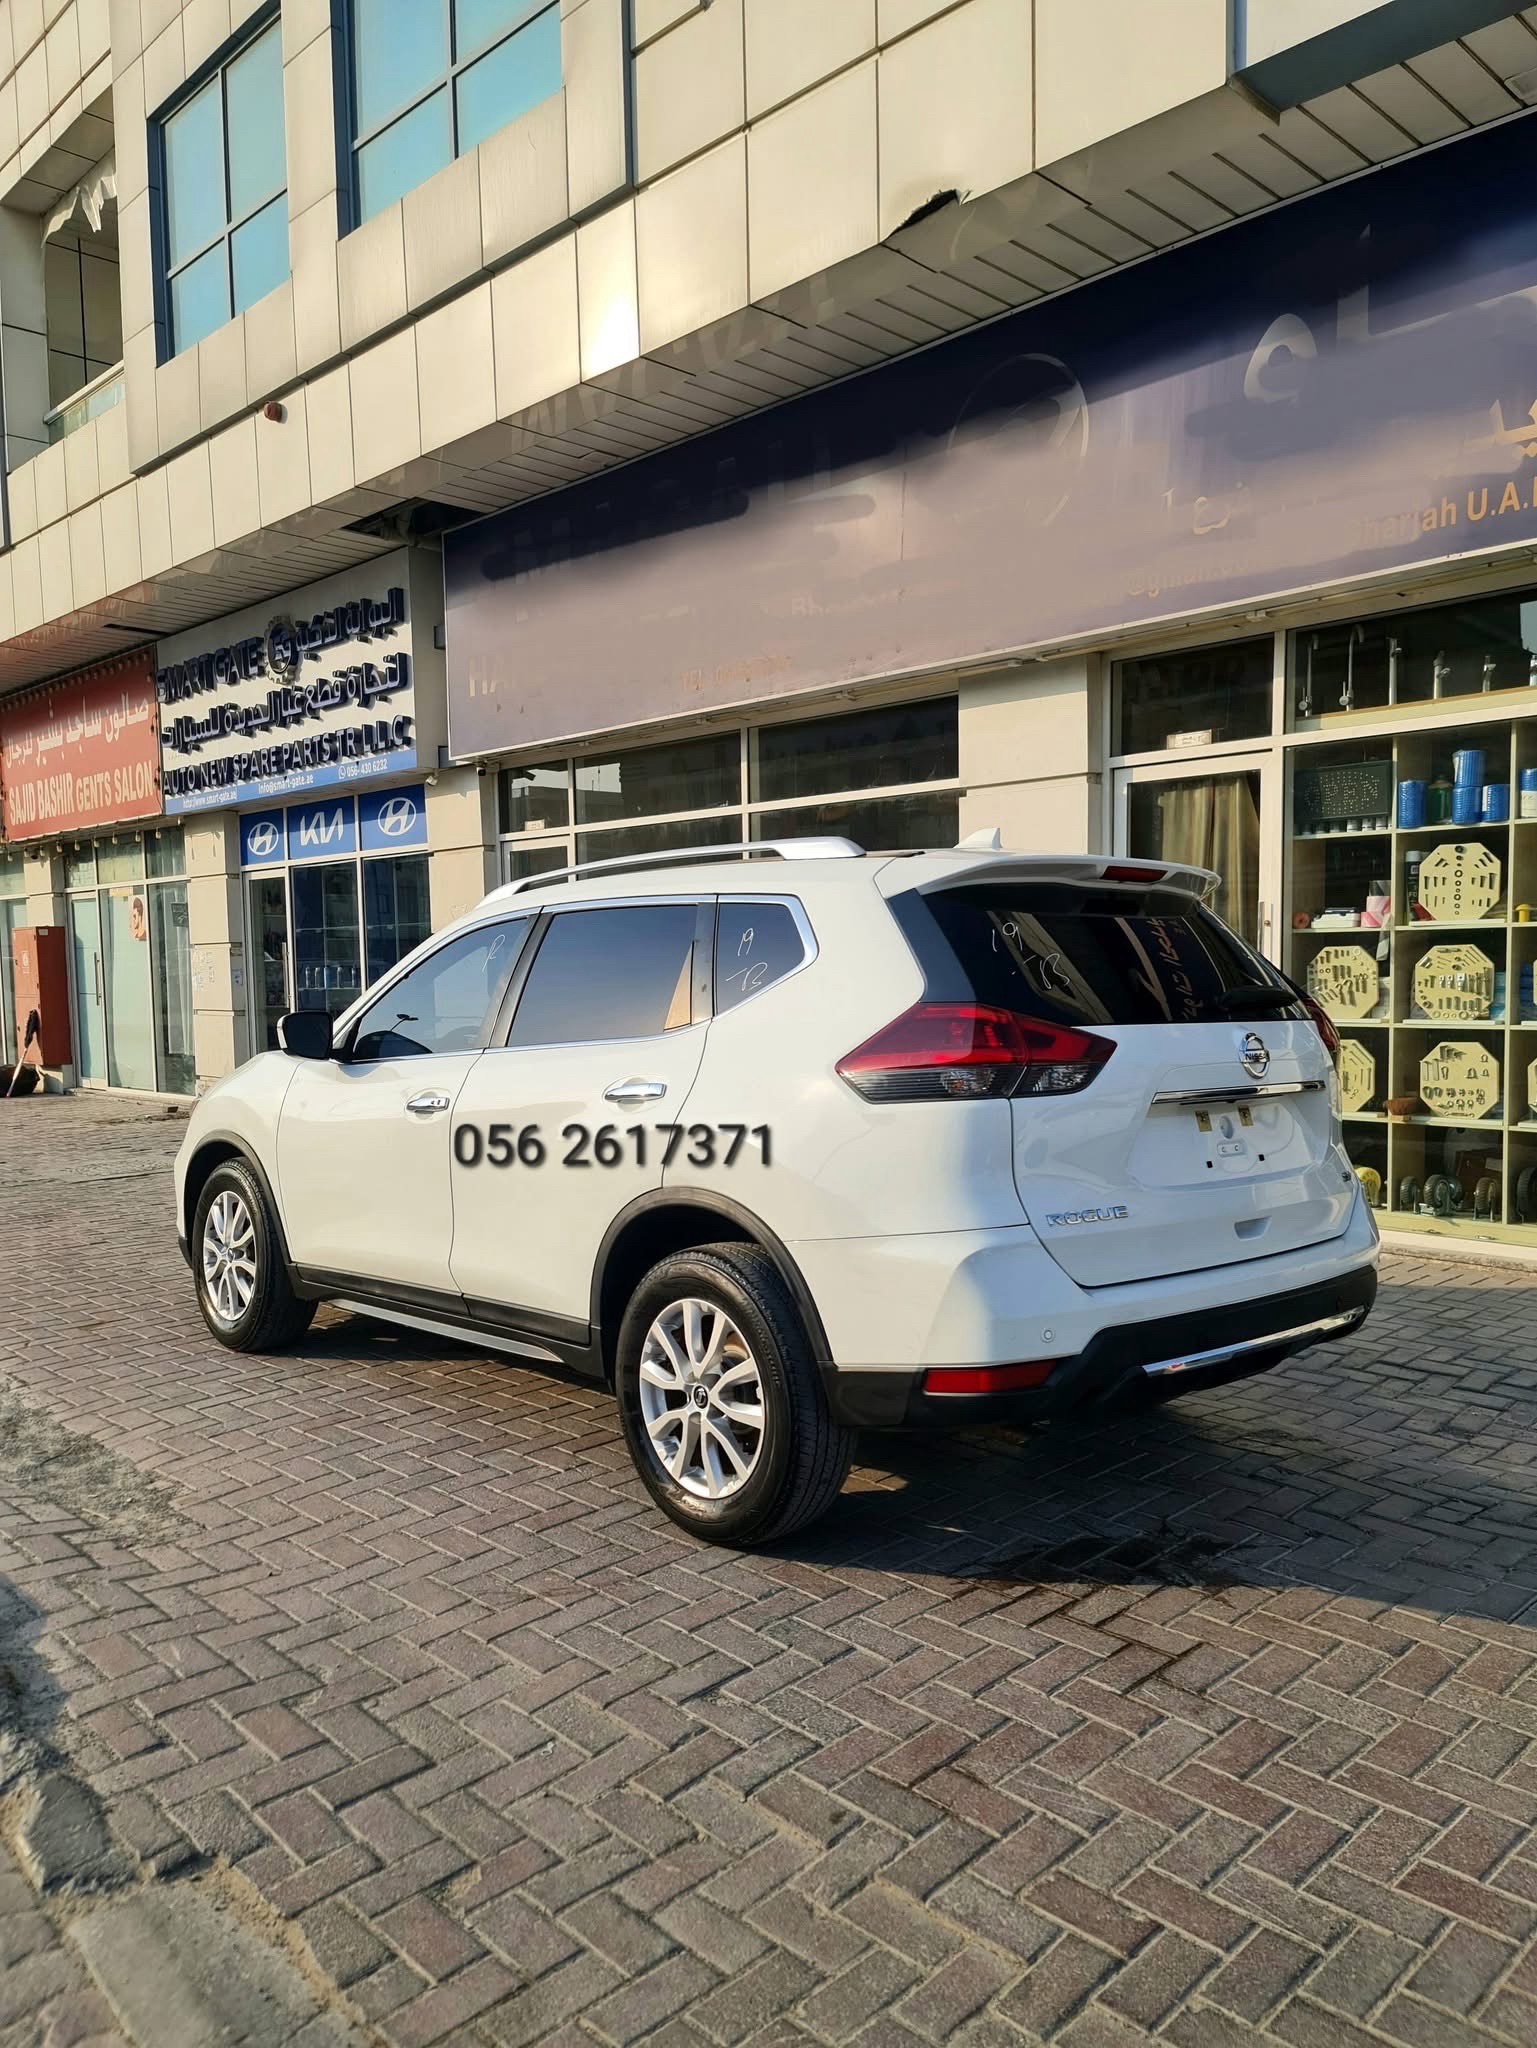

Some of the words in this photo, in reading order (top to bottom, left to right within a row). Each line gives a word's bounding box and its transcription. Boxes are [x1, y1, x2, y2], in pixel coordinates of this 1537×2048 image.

[1466, 474, 1537, 521] U.A.
[156, 652, 217, 704] SMART
[214, 636, 268, 685] GATE
[162, 764, 202, 796] AUTO
[199, 754, 236, 790] NEW
[232, 745, 282, 780] SPARE
[281, 732, 335, 771] PARTS
[335, 725, 361, 758] TR
[9, 782, 36, 826] SAJID
[37, 772, 75, 820] BASHIR
[76, 771, 111, 812] GENTS
[114, 759, 154, 804] SALON
[300, 807, 344, 846] KIA
[1045, 1205, 1129, 1228] ROGUE
